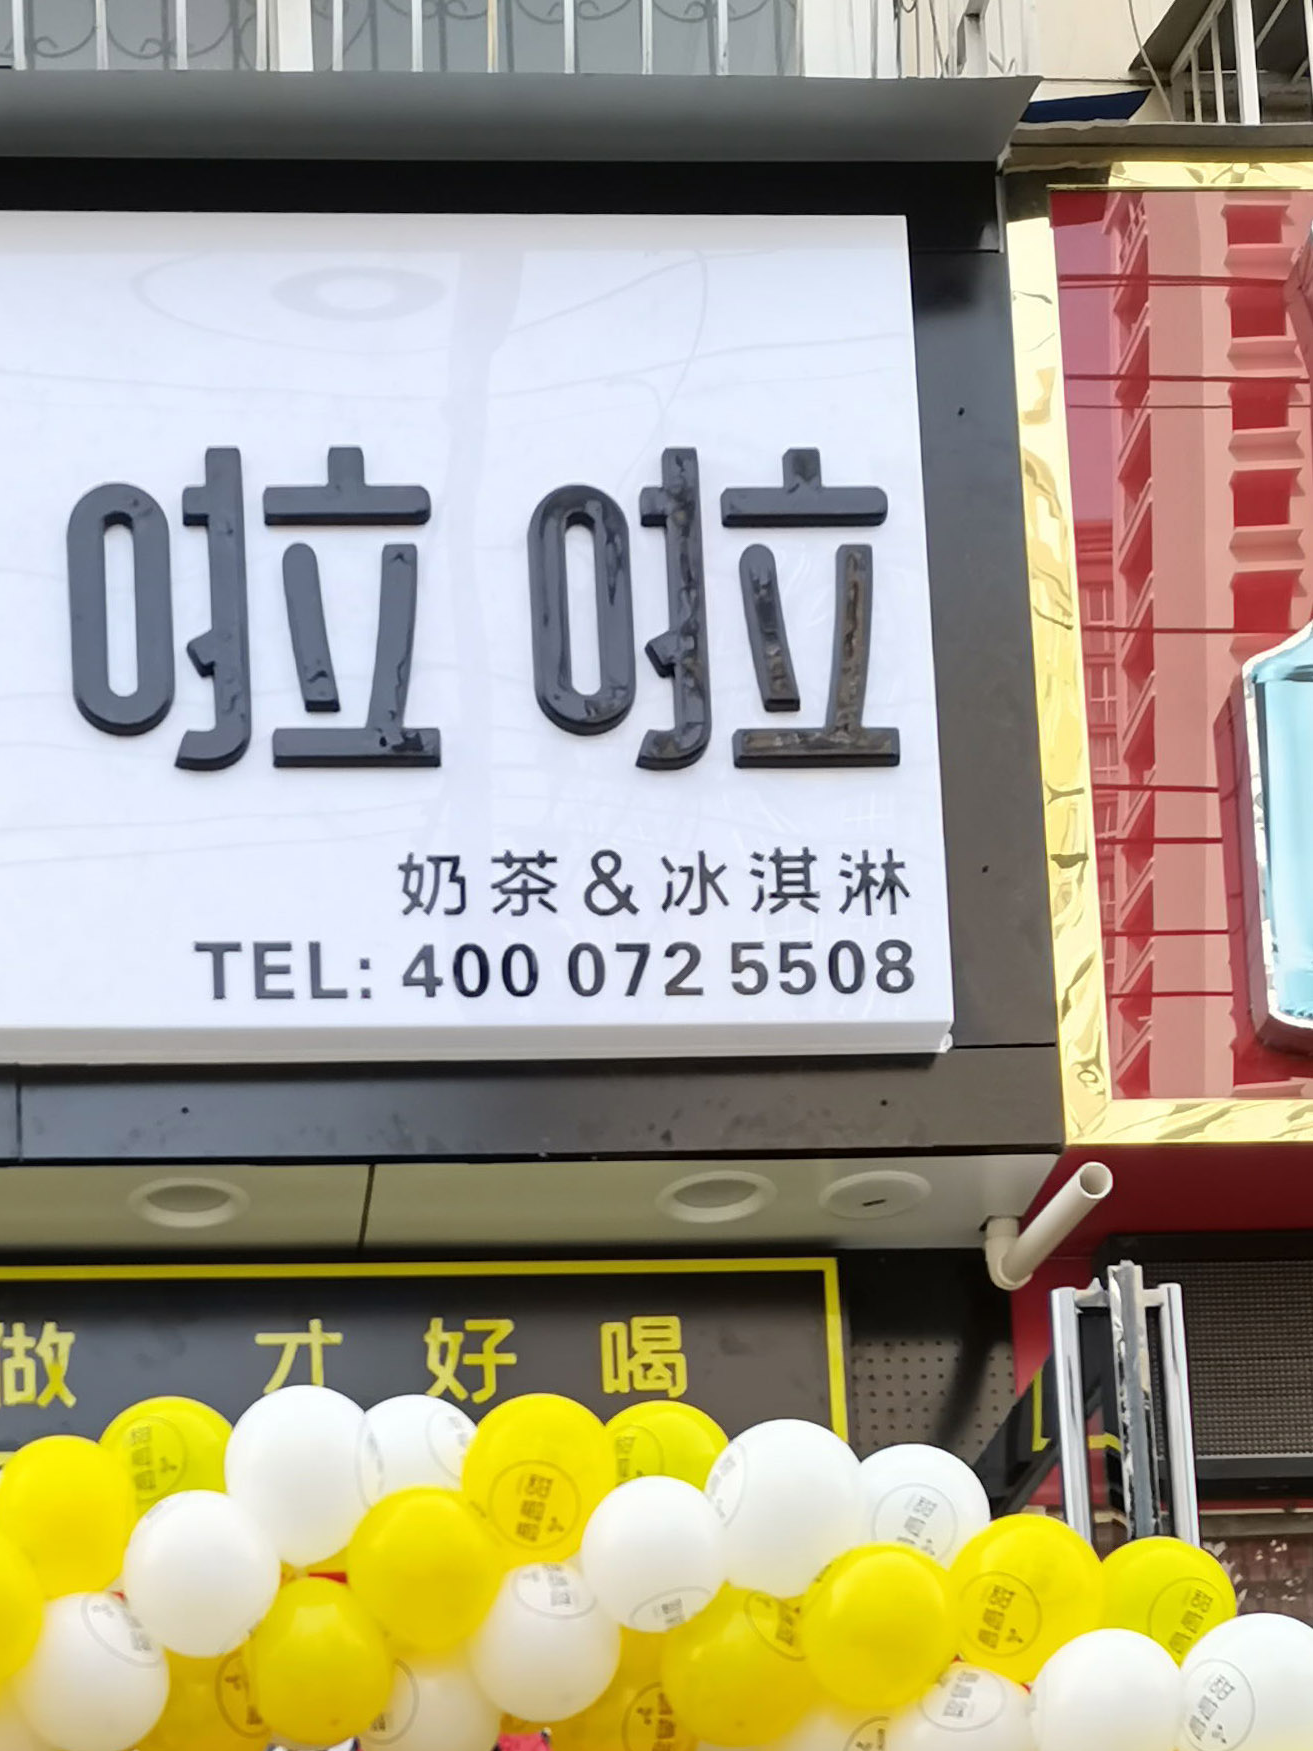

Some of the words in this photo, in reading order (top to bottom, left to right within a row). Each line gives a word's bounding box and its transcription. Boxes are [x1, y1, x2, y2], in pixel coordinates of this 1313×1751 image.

[398, 847, 910, 917] 奶茶&冰淇淋
[193, 941, 372, 1000] TEL:
[402, 942, 539, 999] 400
[567, 941, 704, 998] 072
[730, 938, 915, 996] 5508
